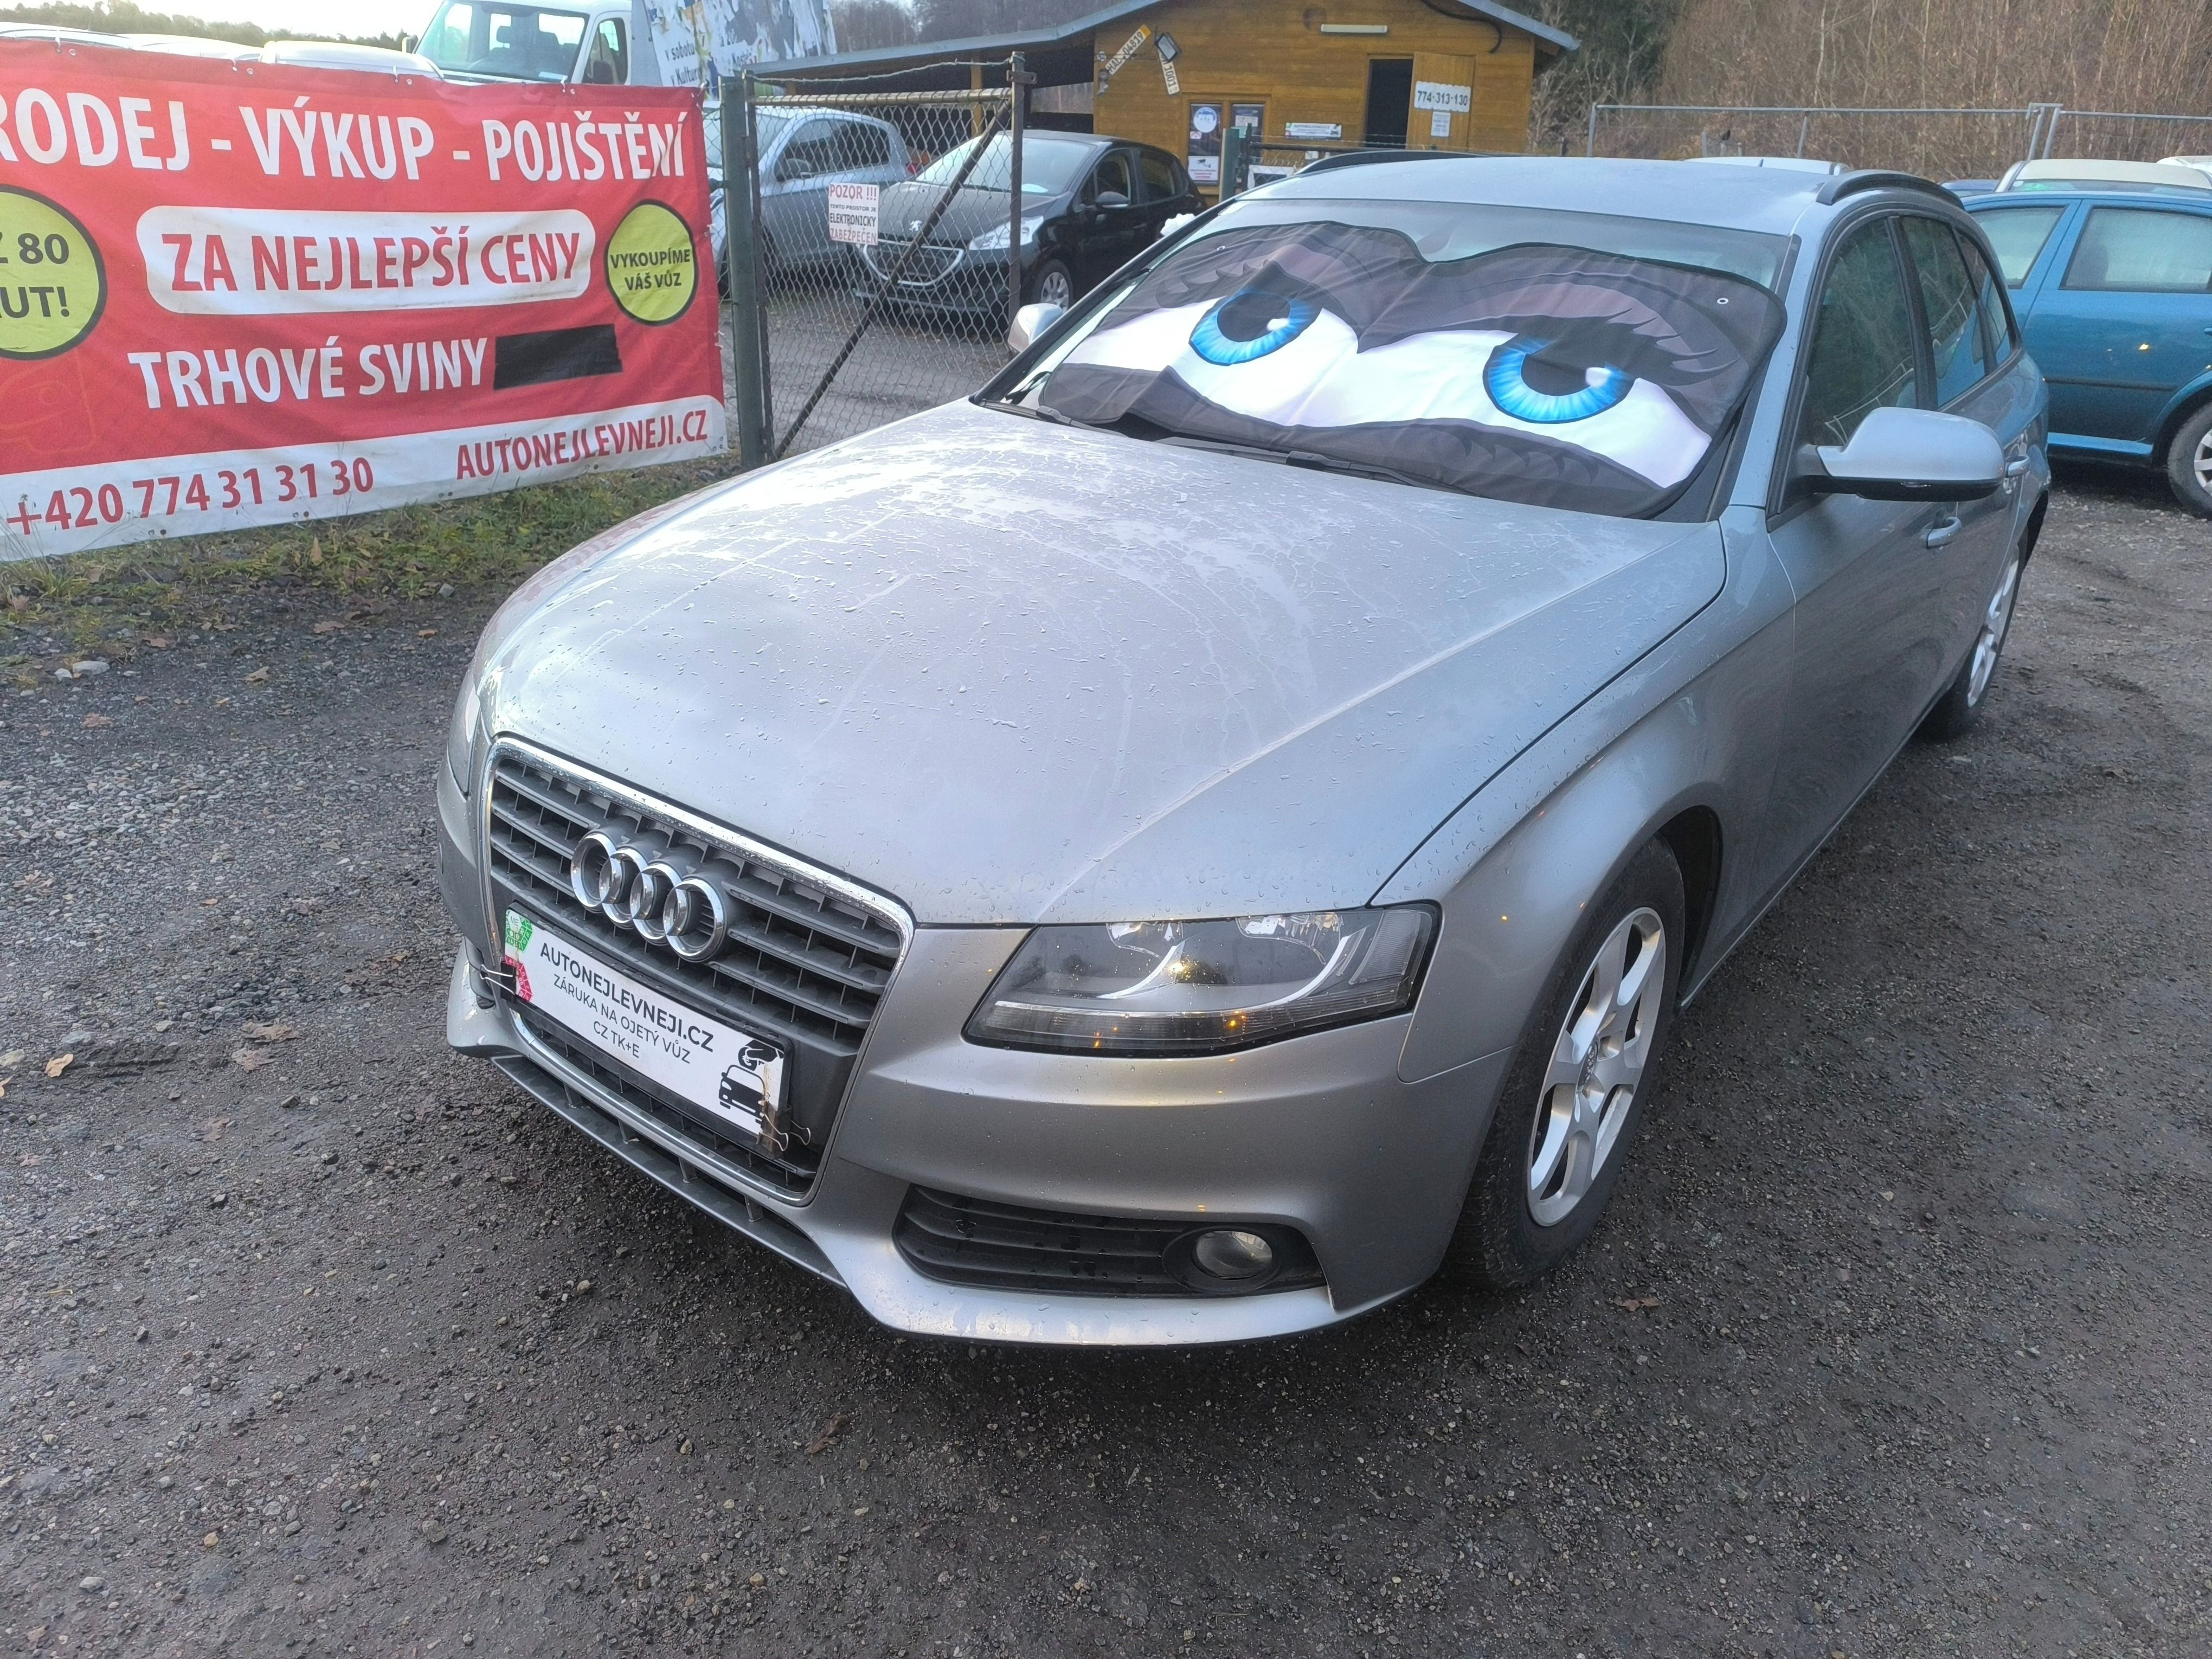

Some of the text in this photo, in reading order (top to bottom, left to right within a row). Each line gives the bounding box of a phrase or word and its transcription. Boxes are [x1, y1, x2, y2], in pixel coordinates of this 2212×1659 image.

[671, 40, 696, 61] sobotu
[239, 96, 434, 181] VÝKUP
[482, 110, 687, 182] POJIŠTĚNÍ
[830, 184, 863, 200] POZOR
[830, 213, 877, 227] ELEKTRONICKY
[830, 228, 877, 244] ZABEZPEČEN
[17, 233, 69, 264] 80
[162, 226, 580, 291] ZA NEJLEPŠÍ CENY
[610, 247, 691, 269] VYKOUPÍME
[624, 269, 682, 291] VÁŠ VŮZ
[0, 286, 70, 318] UT!
[127, 336, 487, 409] TRHOVÉ SVINY
[456, 409, 708, 480] AUTONEJLEVNEJI.CZ
[7, 457, 374, 535] +420 774 31 31 30
[540, 942, 714, 1053] AUTONEJLEVNEJI.CZ
[554, 974, 598, 1013] ZÁRUKA
[601, 1004, 618, 1024] NA
[620, 1015, 659, 1046] OJETÝ
[662, 1037, 691, 1064] VŮZ
[593, 1020, 640, 1058] CZ TK+E
